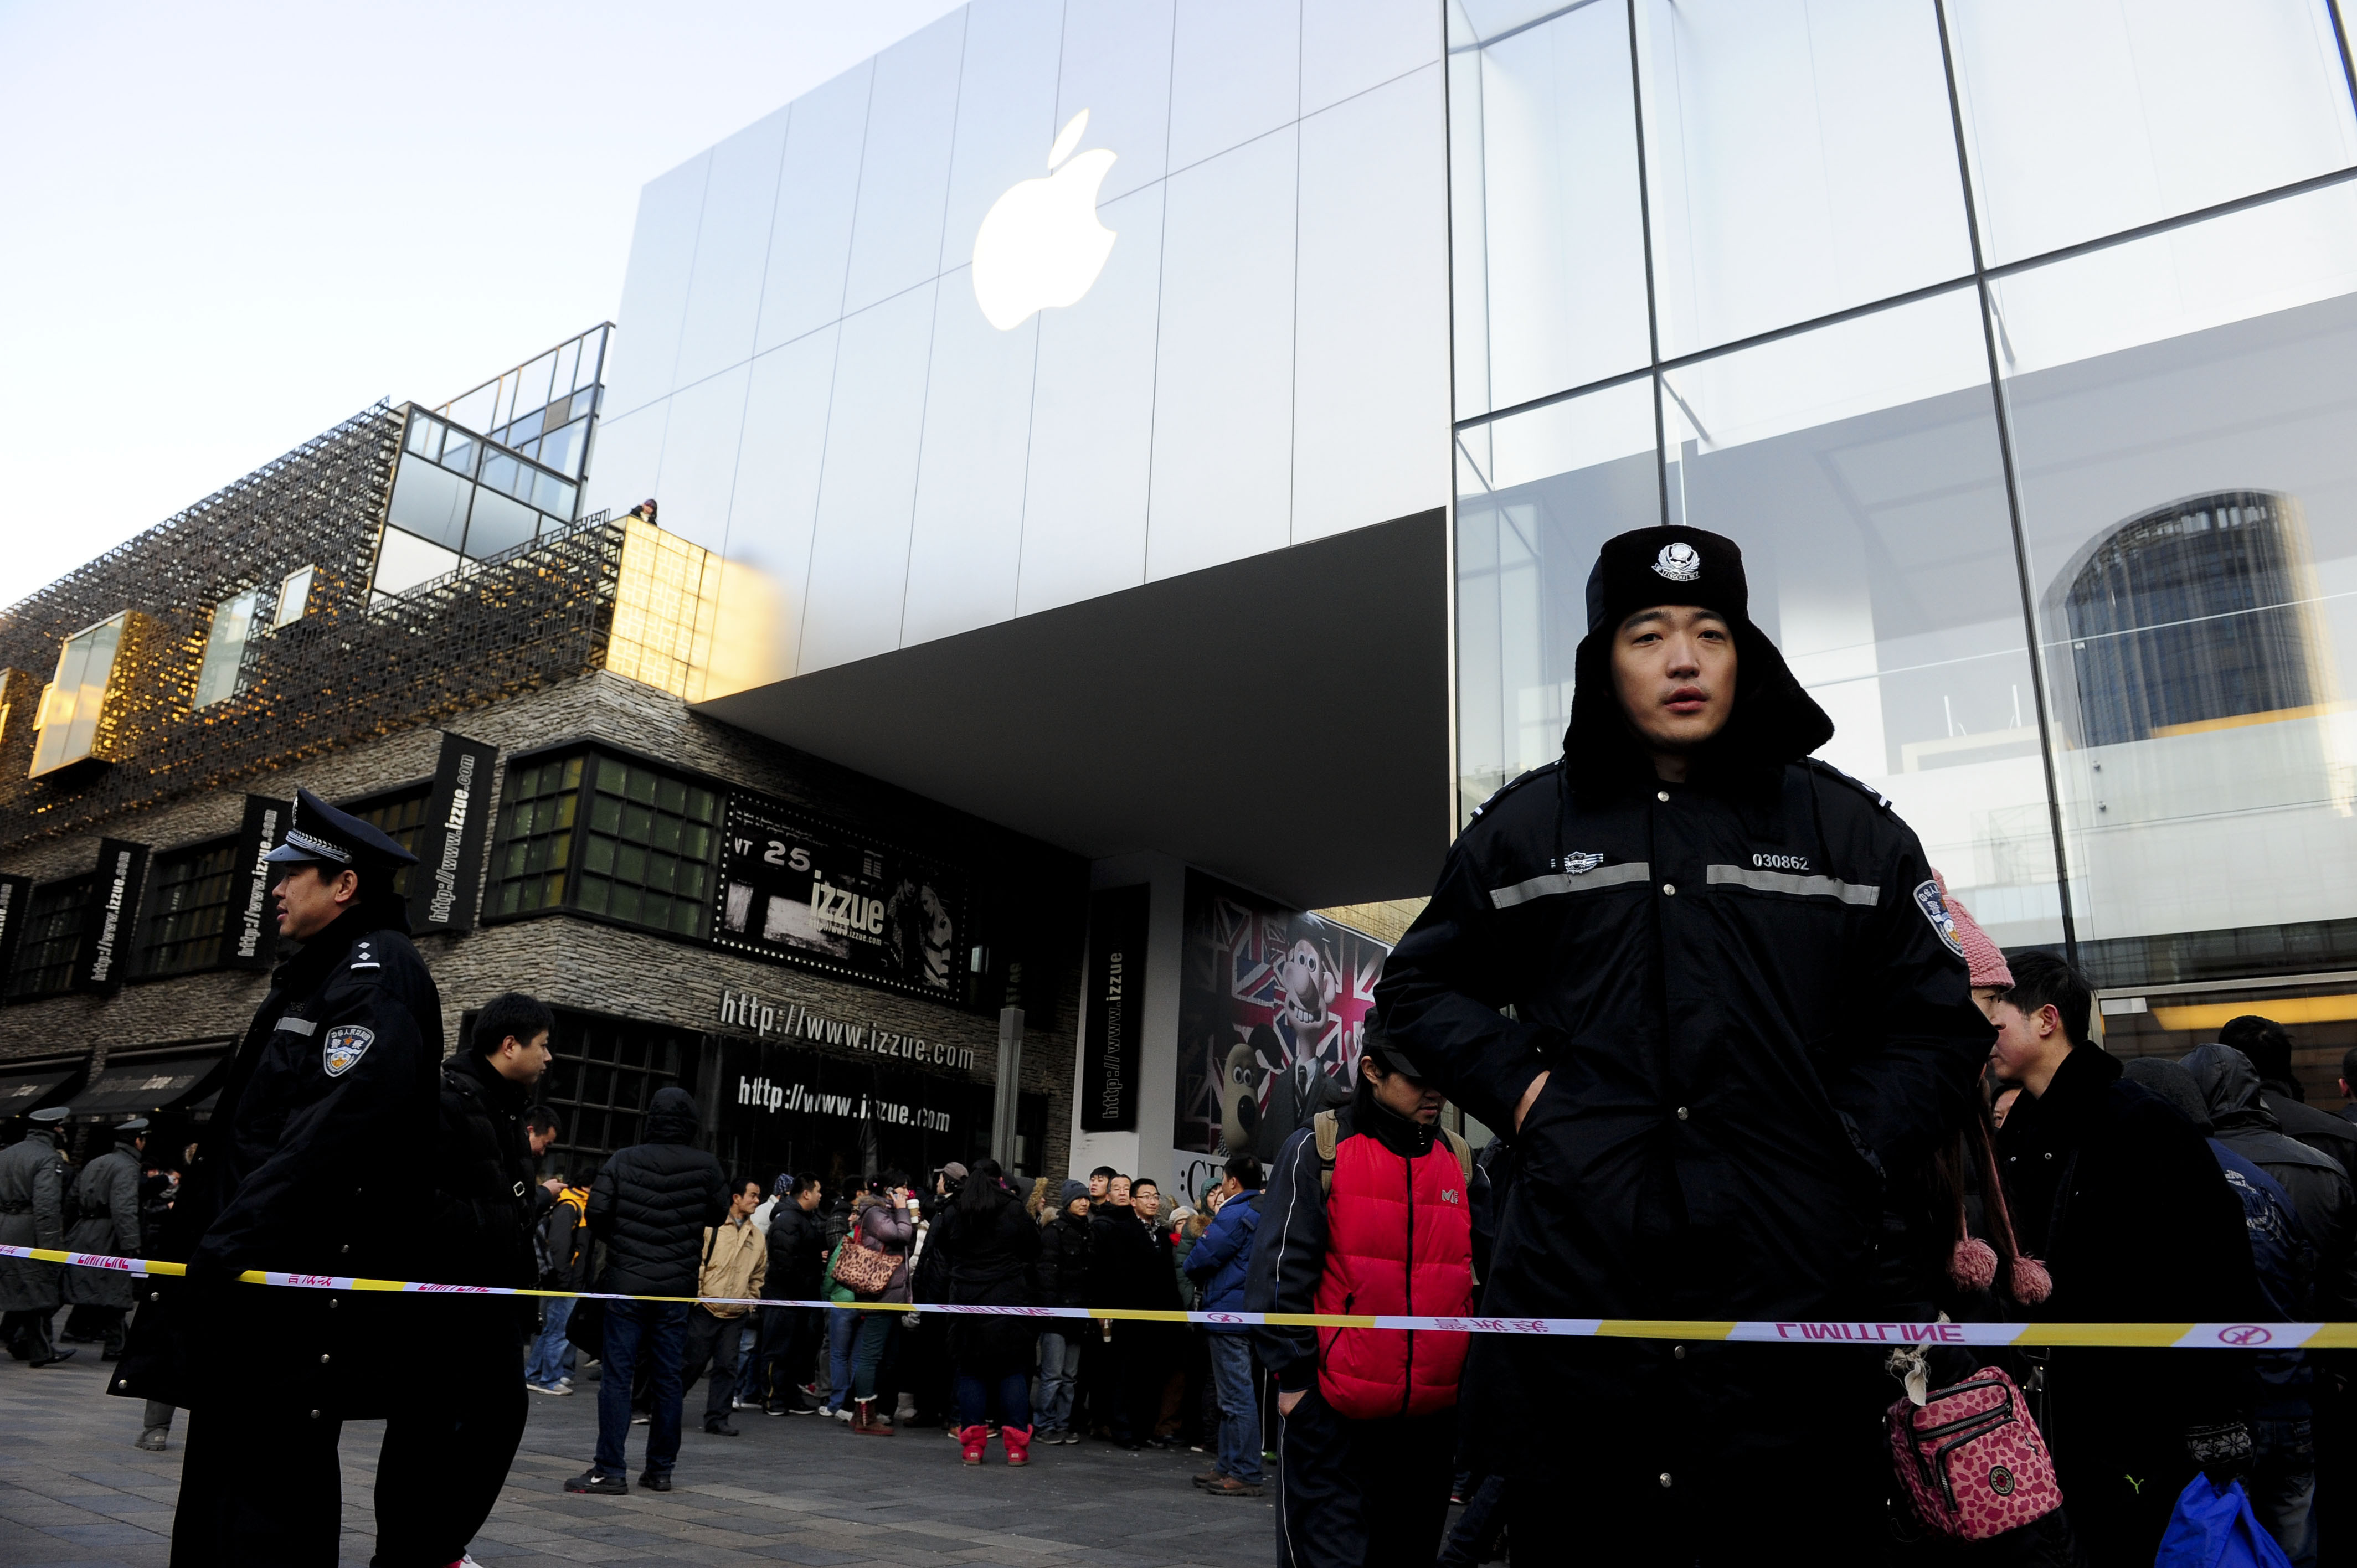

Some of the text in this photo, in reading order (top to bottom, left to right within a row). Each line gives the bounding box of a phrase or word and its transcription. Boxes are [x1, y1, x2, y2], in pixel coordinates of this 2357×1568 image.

[429, 754, 475, 923] http://www.izzue.com
[764, 840, 810, 871] 25
[1753, 853, 1810, 870] 030862
[90, 850, 131, 981] http://www.izzue.com
[237, 809, 277, 957] http://www.izzue.com
[810, 870, 884, 935] izzue
[721, 990, 974, 1070] http://www.izzue.com
[738, 1076, 950, 1132] http://www.izue.com
